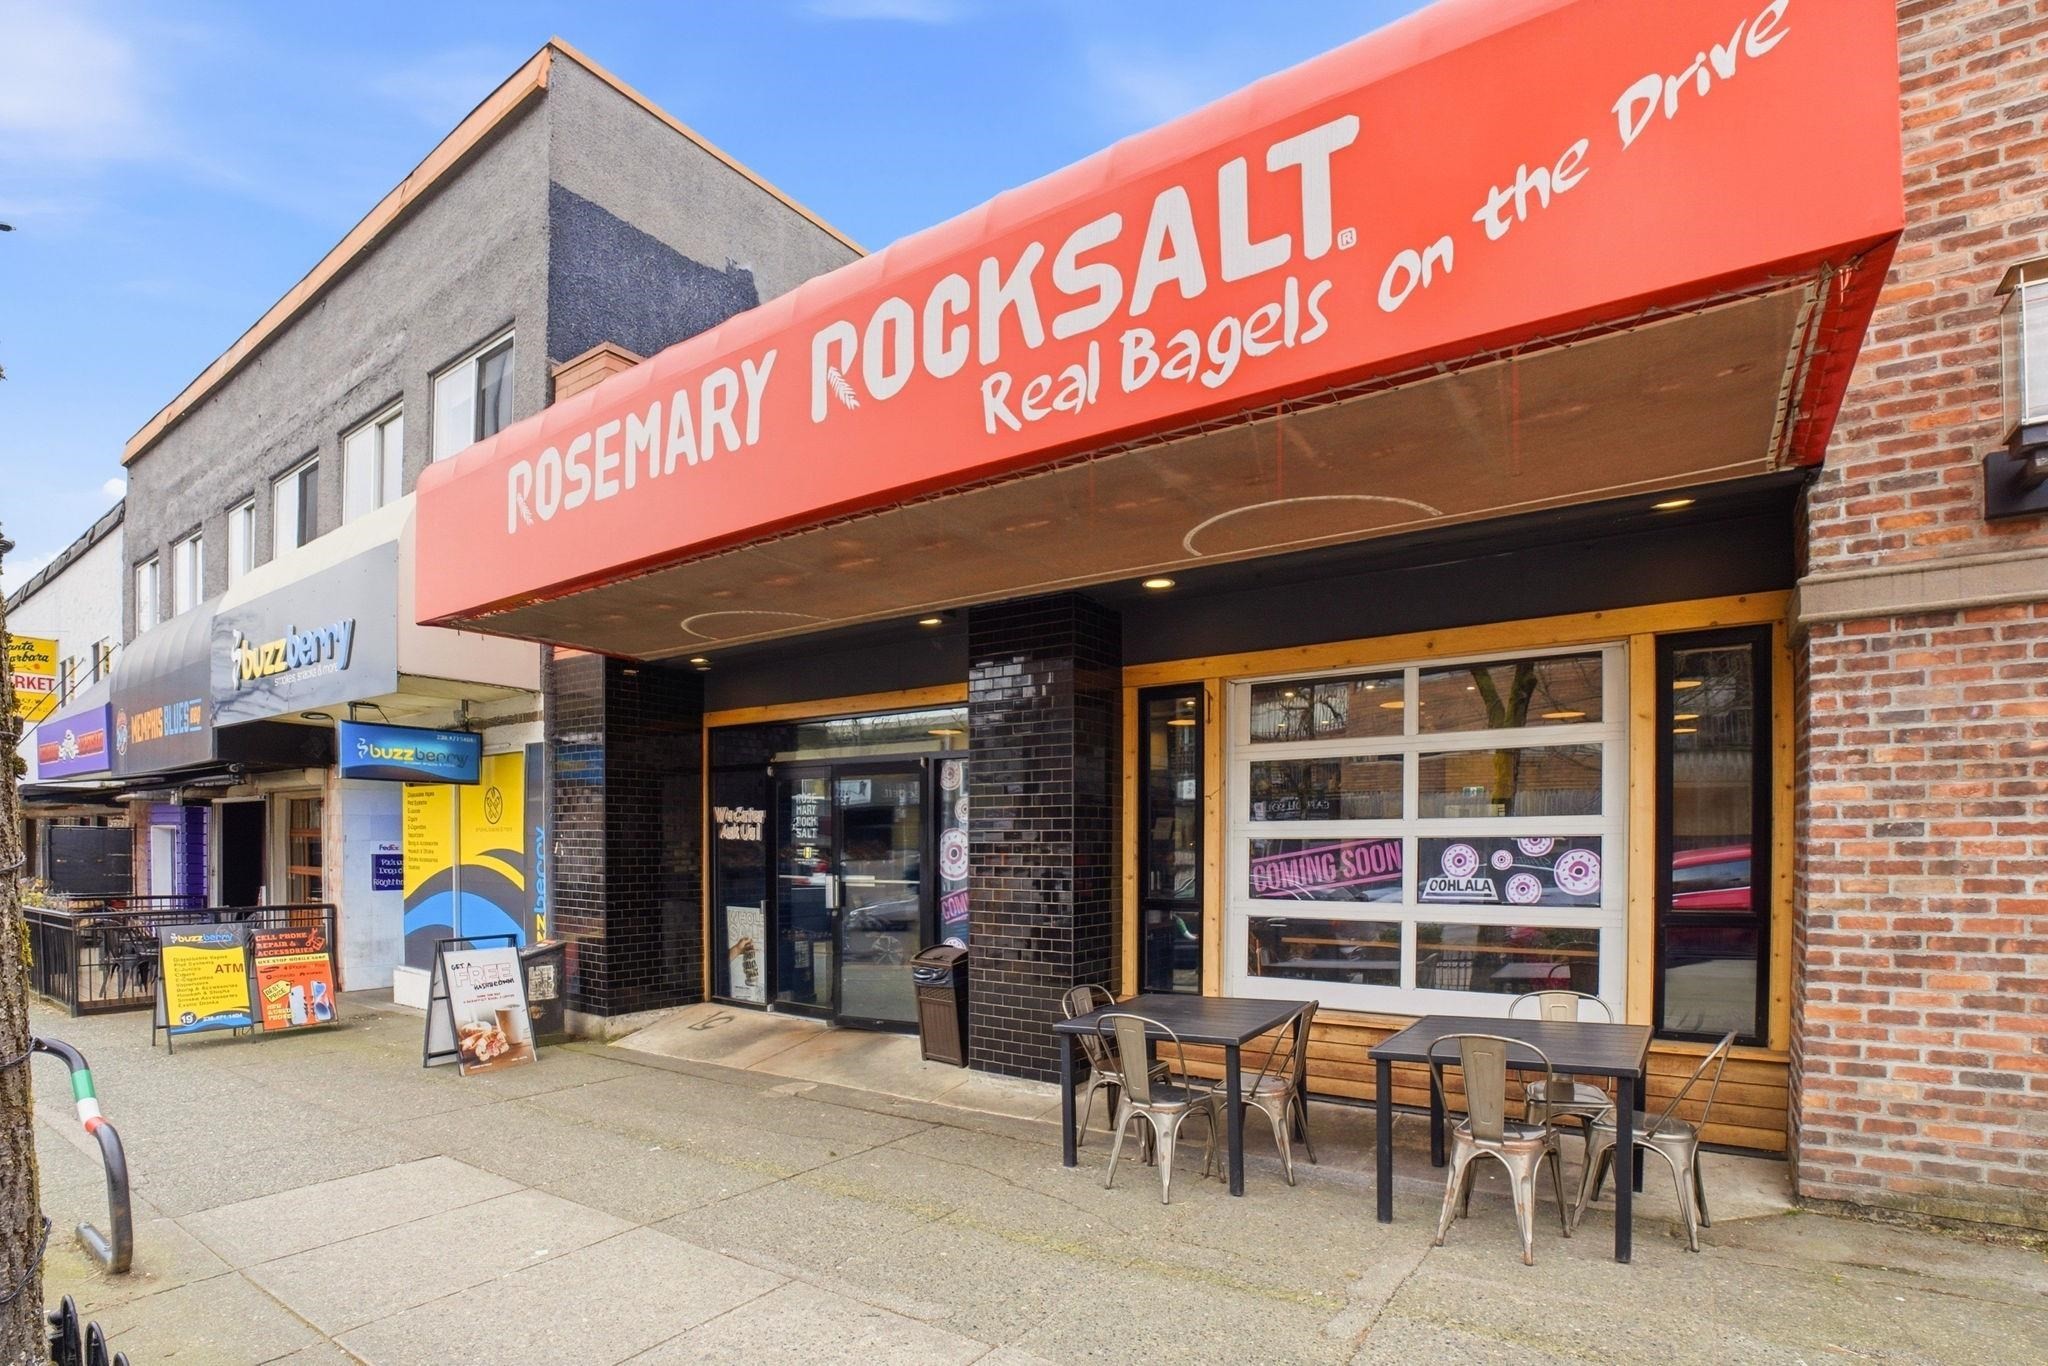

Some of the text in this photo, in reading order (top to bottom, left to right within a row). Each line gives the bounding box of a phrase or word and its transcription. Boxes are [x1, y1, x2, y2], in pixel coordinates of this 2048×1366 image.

[981, 353, 1099, 436] Real
[1119, 276, 1334, 389] Bagels
[1472, 138, 1590, 240] the
[1611, 0, 1792, 151] Drive
[506, 113, 1360, 534] ROSEMARY ROCKSALT
[8, 641, 34, 652] anta
[241, 619, 355, 680] buzzberry
[9, 651, 49, 662] arbara
[15, 675, 55, 690] RKET
[131, 707, 163, 744] MEMPHIS
[164, 701, 189, 736] BLUES
[370, 744, 468, 768] buzzberry
[796, 827, 818, 838] SALT
[1253, 840, 1402, 892] COMING SOON
[1429, 879, 1492, 892] OOHLALA
[255, 934, 278, 942] CELL
[256, 941, 288, 949] REPAIR
[257, 947, 314, 957] ACCESSORIES
[215, 963, 244, 974] ATM
[451, 963, 464, 971] GET
[454, 963, 512, 987] FREE
